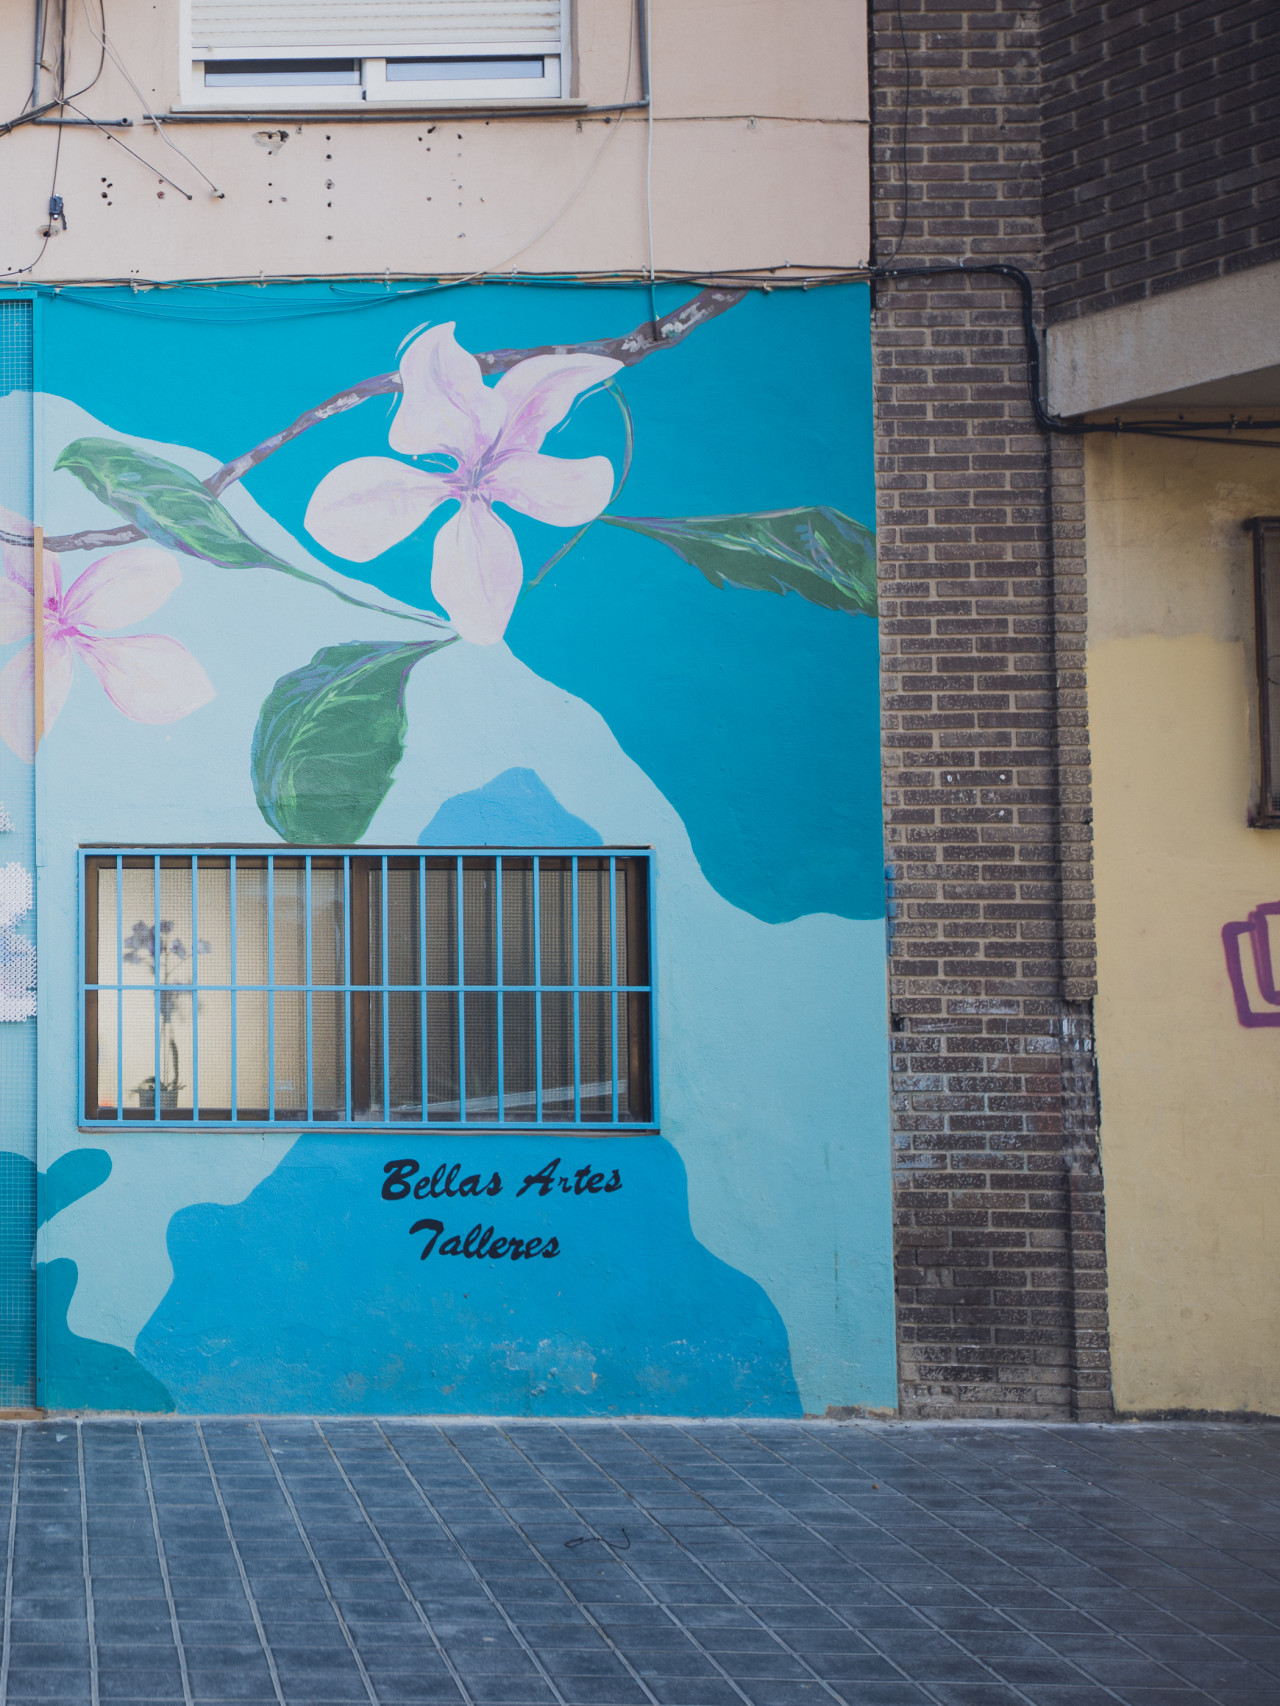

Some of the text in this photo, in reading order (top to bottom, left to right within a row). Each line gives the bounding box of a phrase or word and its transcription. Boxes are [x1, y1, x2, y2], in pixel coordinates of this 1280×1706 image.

[380, 1157, 623, 1201] Bellas Artes
[408, 1218, 561, 1261] Talleres
